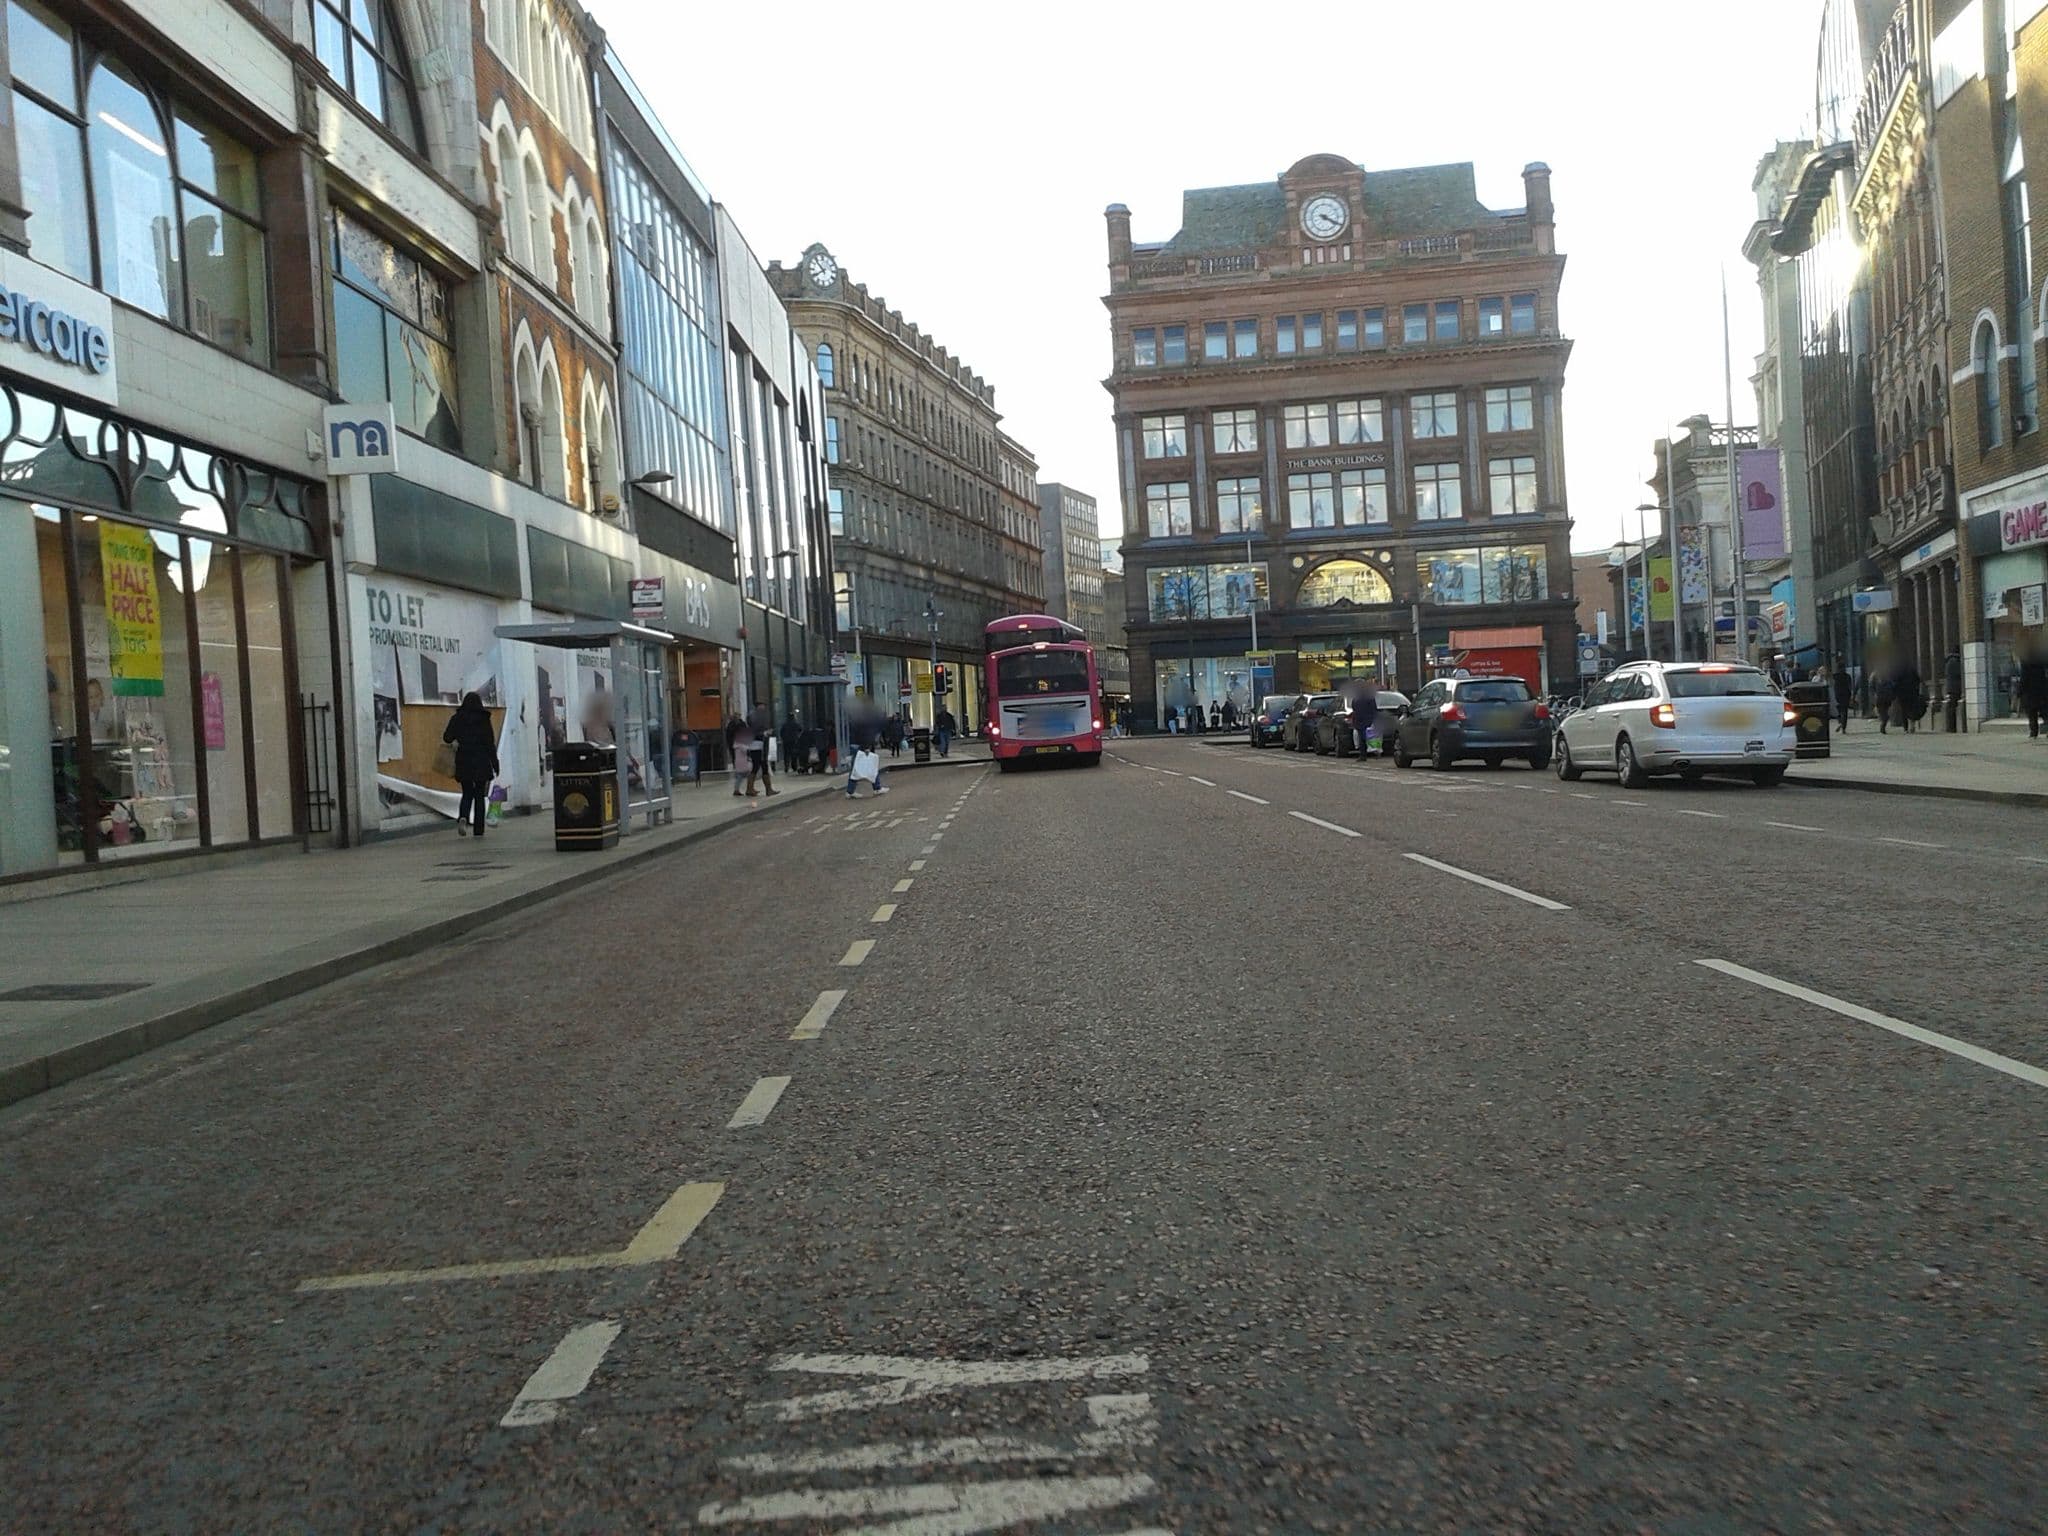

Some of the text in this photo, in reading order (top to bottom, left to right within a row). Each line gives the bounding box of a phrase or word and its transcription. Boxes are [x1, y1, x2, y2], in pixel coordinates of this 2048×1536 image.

[1308, 459, 1333, 468] BANK
[1334, 454, 1385, 466] BUILDINGS
[2002, 500, 2048, 546] GAME
[109, 561, 150, 595] HALF
[111, 593, 155, 624] PRICE
[366, 588, 424, 629] TO LET
[123, 636, 148, 655] TOYS
[369, 626, 460, 654] PROMINENT RETAIL UNIT
